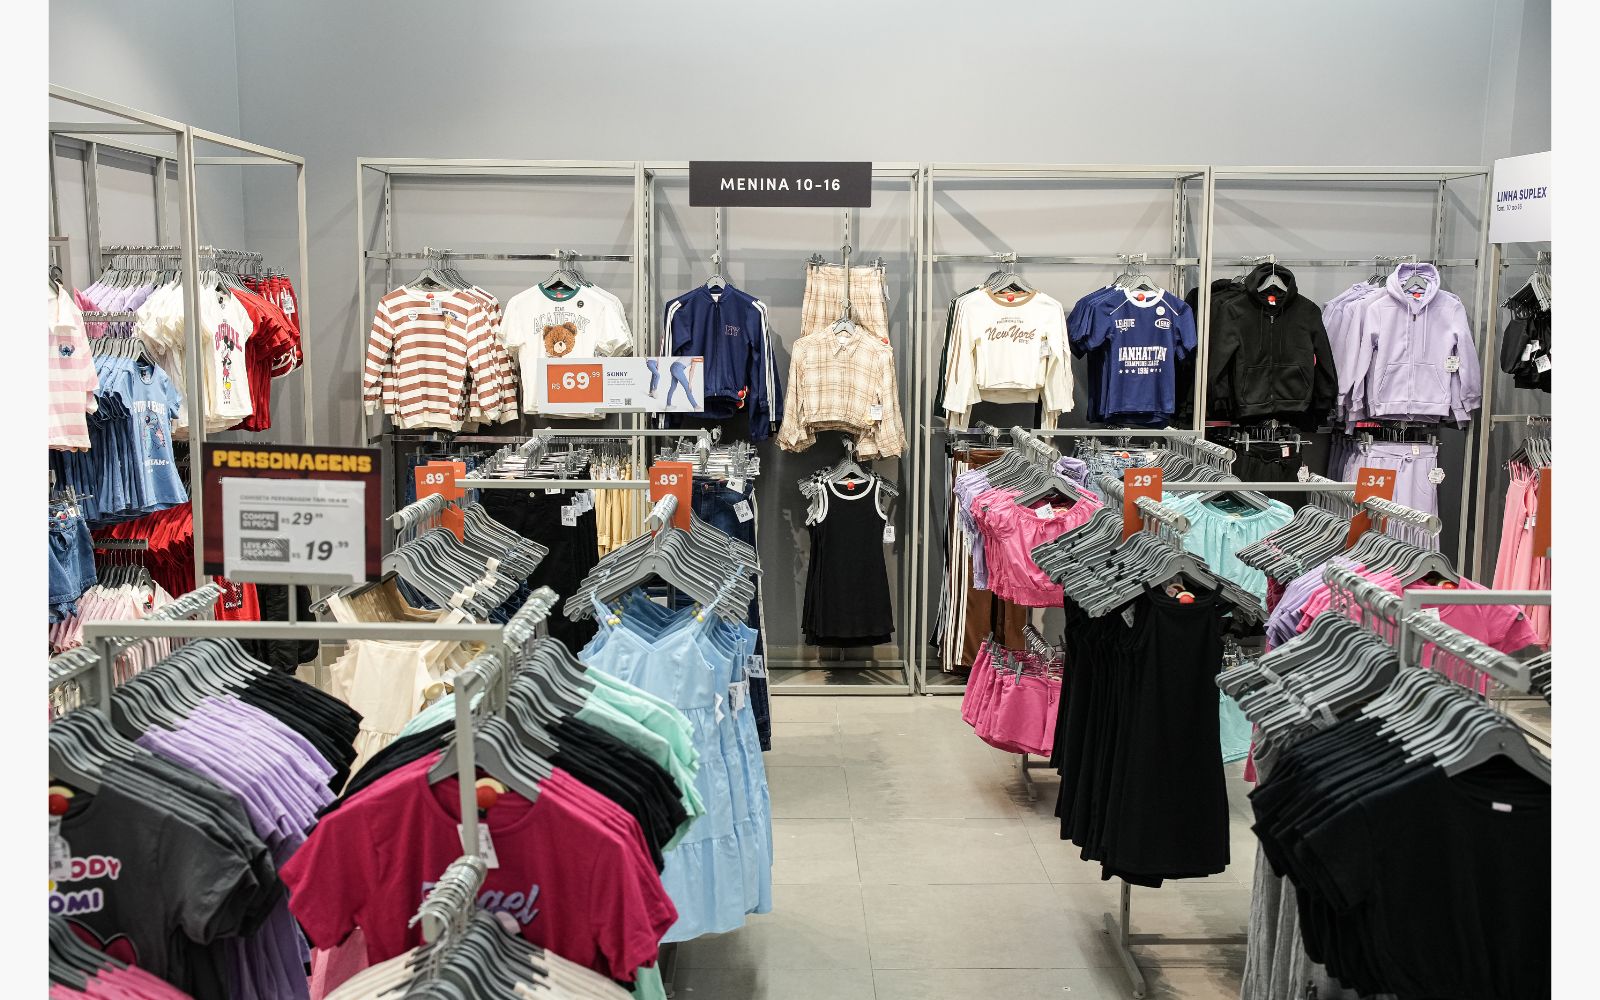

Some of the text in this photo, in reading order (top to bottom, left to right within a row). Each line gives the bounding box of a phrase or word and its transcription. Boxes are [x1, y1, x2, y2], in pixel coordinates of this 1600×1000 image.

[720, 177, 841, 191] MENINA 10-16
[1496, 186, 1547, 203] LINHA SUPLEX
[984, 324, 1037, 342] New York
[562, 371, 590, 390] 69
[213, 450, 372, 473] PERSONAGENS
[425, 472, 444, 485] 89
[660, 474, 678, 486] 89
[1133, 475, 1152, 487] 29
[1367, 475, 1385, 488] 34
[291, 512, 313, 525] 29
[305, 540, 333, 561] 19
[70, 856, 120, 879] ODY
